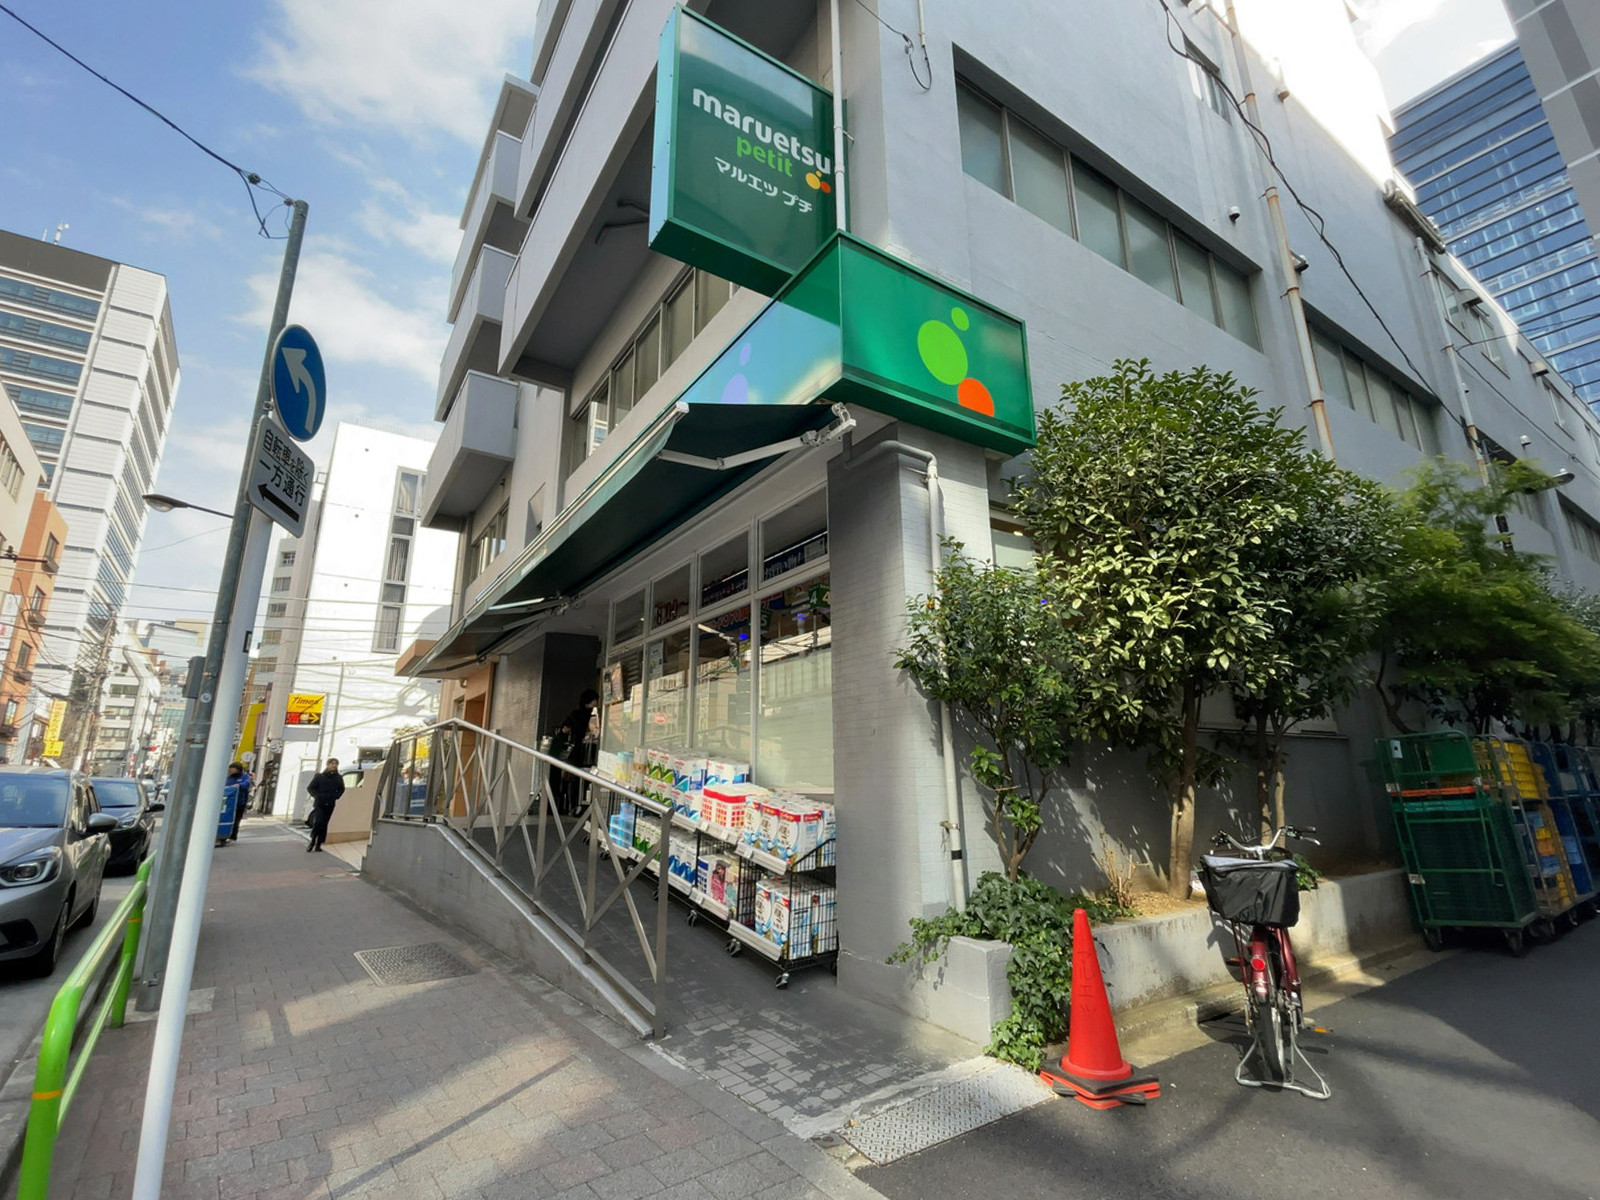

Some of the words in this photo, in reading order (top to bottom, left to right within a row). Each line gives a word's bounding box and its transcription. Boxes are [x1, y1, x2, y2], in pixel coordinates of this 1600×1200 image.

[693, 88, 831, 174] maruetsu
[736, 136, 793, 177] petit
[714, 156, 778, 197] マルエツ
[782, 190, 813, 213] プチ
[259, 459, 307, 507] 一方通行
[262, 429, 309, 486] 自転車を除く
